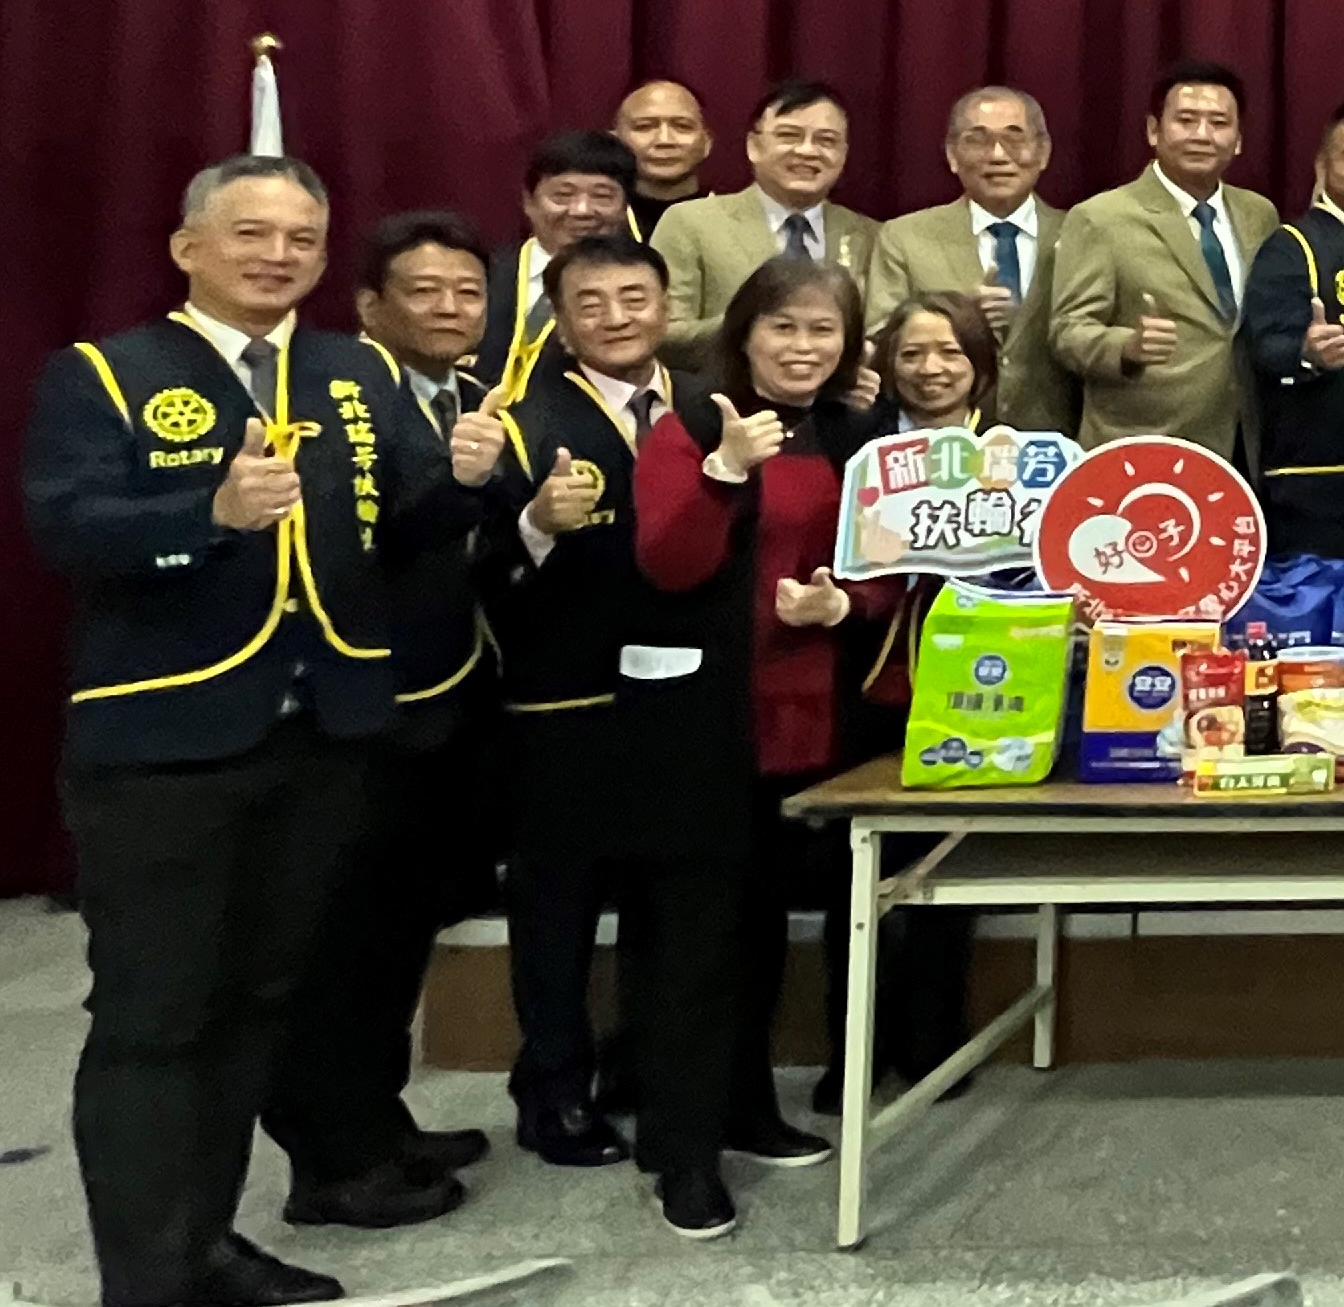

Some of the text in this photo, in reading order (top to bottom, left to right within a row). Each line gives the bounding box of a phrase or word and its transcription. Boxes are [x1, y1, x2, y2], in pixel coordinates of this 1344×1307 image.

[149, 447, 224, 469] Rotary
[885, 441, 1059, 491] 新北瑞芳
